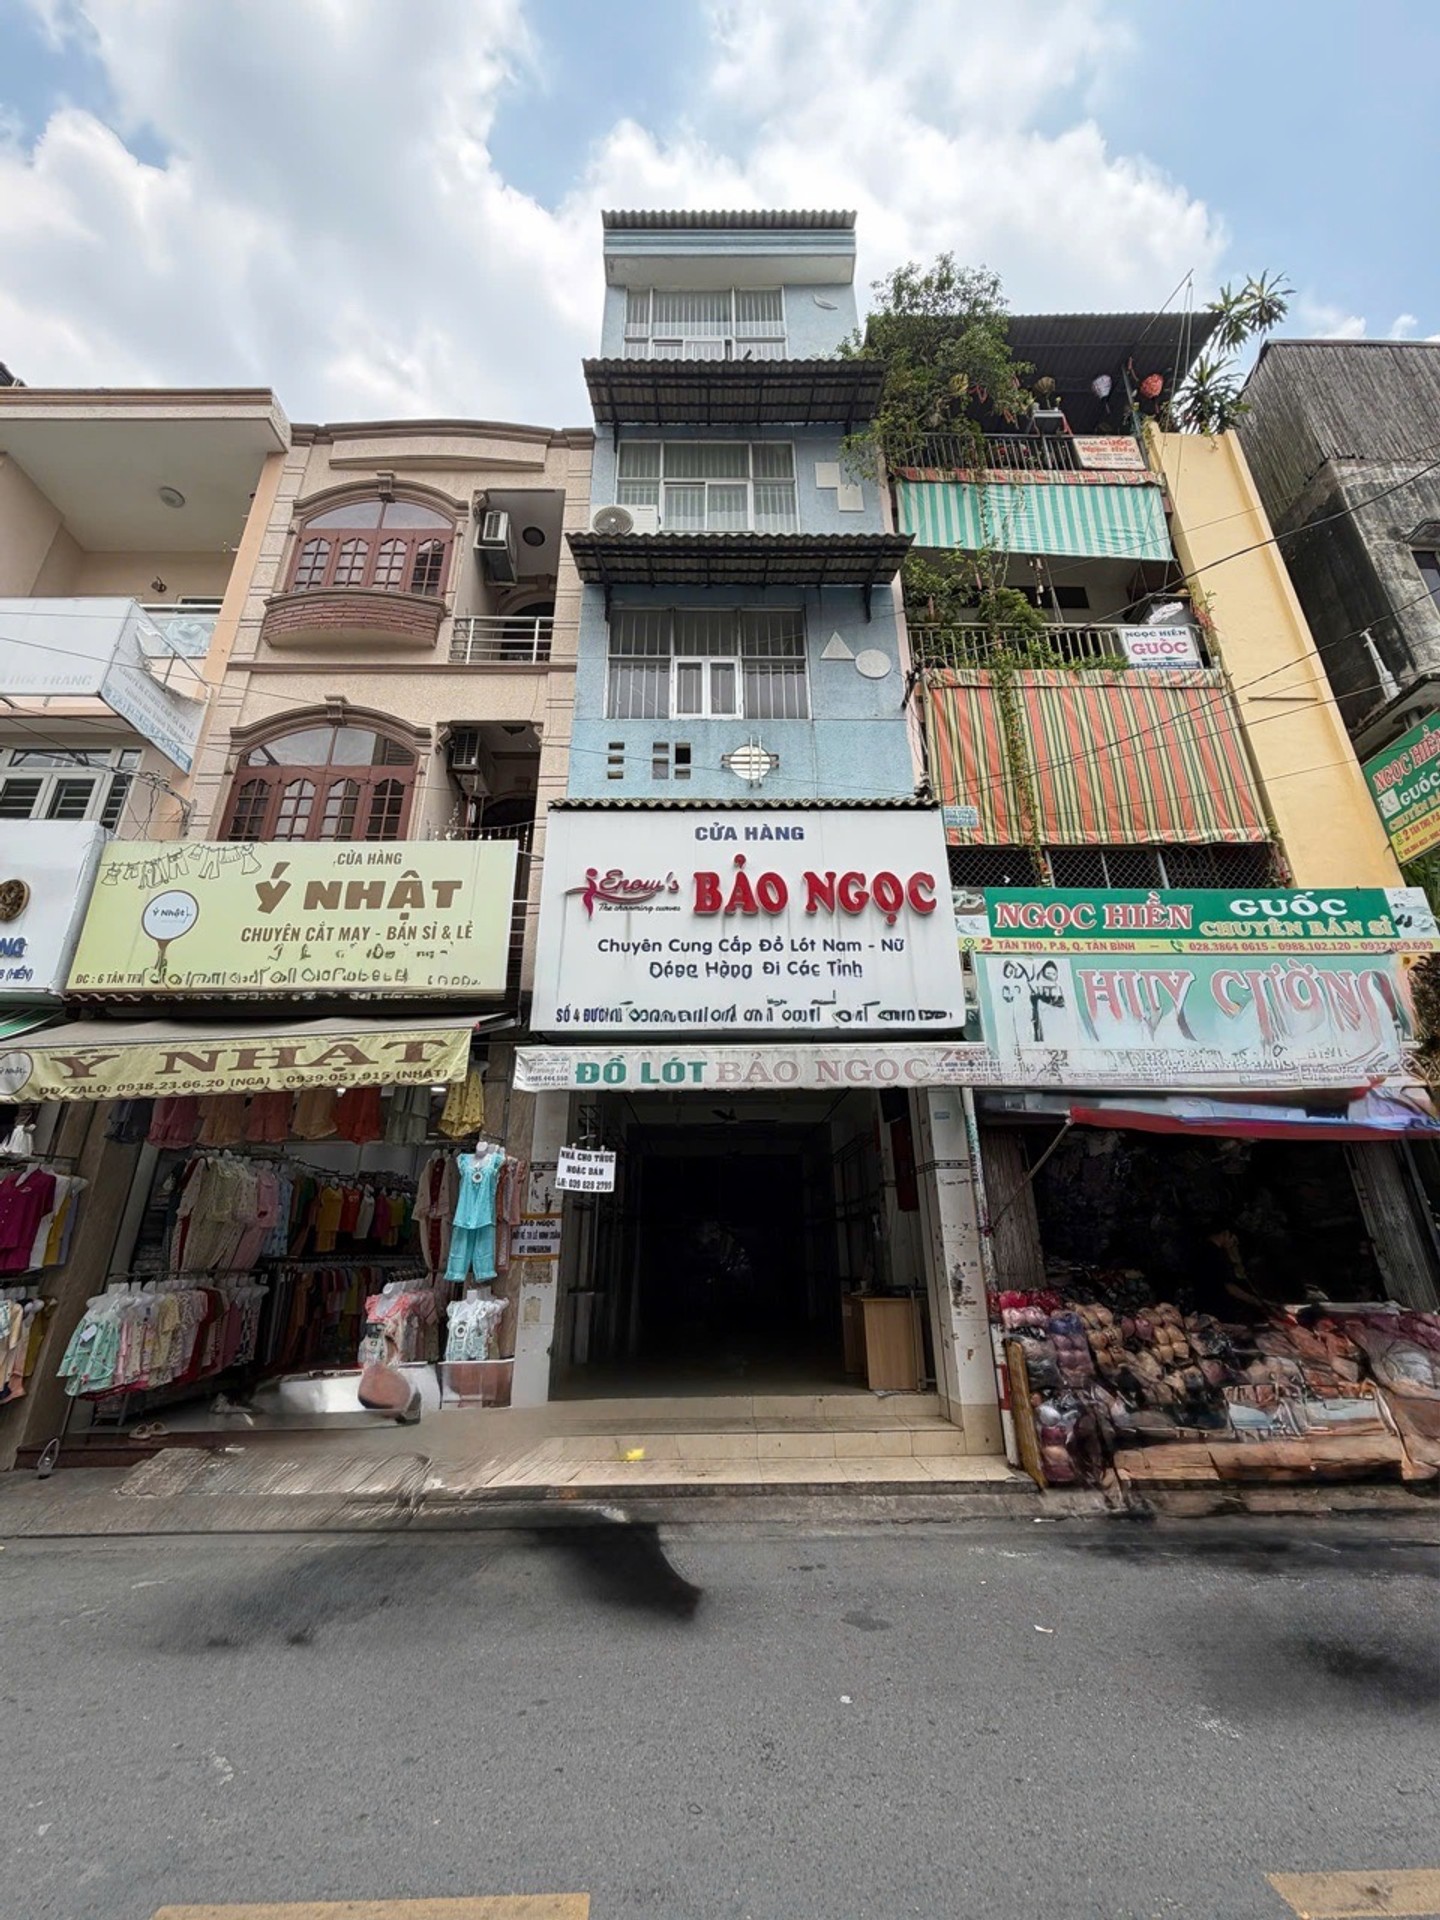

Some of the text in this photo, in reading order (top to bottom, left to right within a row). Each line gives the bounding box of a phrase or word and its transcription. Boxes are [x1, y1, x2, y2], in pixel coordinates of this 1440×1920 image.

[1131, 638, 1188, 655] GUỐC
[694, 822, 805, 841] CỬA HÀNG
[337, 849, 402, 866] CỬA HÀNG
[255, 861, 463, 921] Ý NHẬT
[692, 853, 938, 926] BẢO NGỌC
[994, 891, 1193, 936] NGỌC HIỀN
[1229, 891, 1348, 917] GUỐC
[241, 924, 300, 942] CHUYÊN
[305, 921, 334, 942] CẮT
[338, 926, 371, 941] MAY
[386, 921, 417, 940] BÁN
[441, 925, 451, 940] &
[1200, 917, 1304, 937] CHUYÊN
[1309, 917, 1363, 936] BÁN
[0, 937, 27, 958] NG
[597, 938, 662, 955] Chuyên
[668, 939, 712, 955] Cung
[718, 938, 751, 955] Cấp
[791, 938, 816, 952] Lót
[823, 939, 862, 952] Nam
[881, 937, 905, 952] Nữ
[981, 938, 993, 950] 2
[998, 939, 1019, 950] TÂN
[1072, 941, 1084, 951] Q.
[1086, 940, 1108, 950] TÂN
[1111, 940, 1136, 950] BÌNH
[763, 961, 780, 975] Đi
[787, 959, 820, 977] Các
[826, 959, 863, 978] Tỉnh
[556, 1003, 571, 1022] SỐ
[50, 1037, 449, 1079] Ý NHẬT
[576, 1055, 627, 1084] ĐỒ
[641, 1057, 708, 1083] LÓT
[715, 1053, 799, 1083] BẢO
[815, 1057, 931, 1086] NGỌC
[116, 1078, 225, 1092] 0938.23.66.20
[230, 1076, 271, 1087] (NGA)
